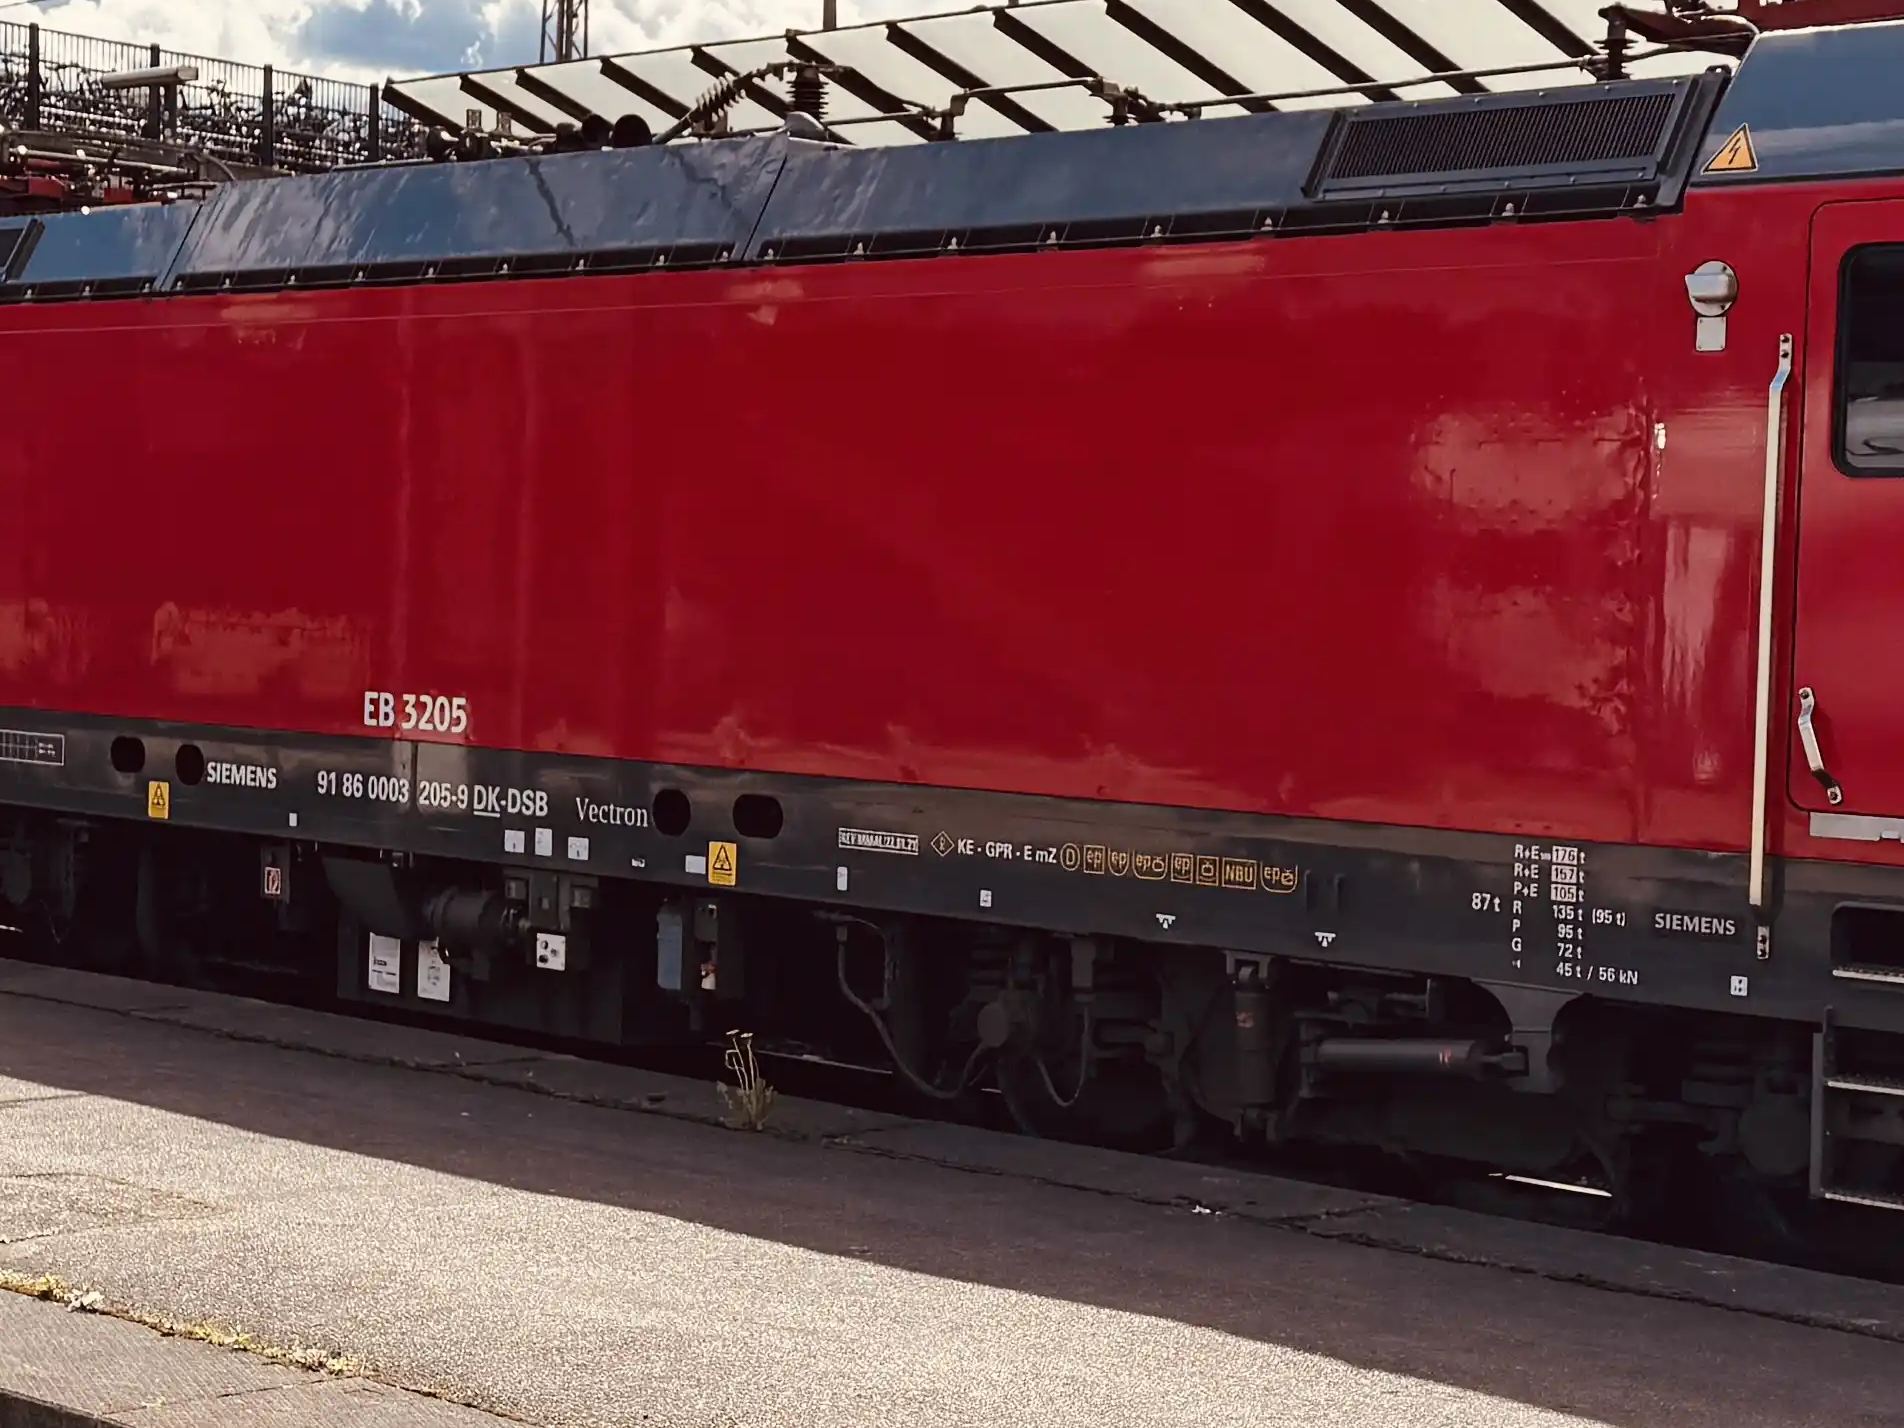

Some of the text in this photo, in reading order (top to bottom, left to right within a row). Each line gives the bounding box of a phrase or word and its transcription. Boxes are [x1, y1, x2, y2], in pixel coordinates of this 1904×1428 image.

[363, 691, 467, 733] EB 3205
[206, 761, 277, 789] SIEMENS
[317, 770, 549, 817] 91 86 0003 205-9 DK-DSB
[575, 797, 648, 828] Vectron
[957, 838, 975, 855] KE
[985, 841, 1012, 860] GPR
[1036, 847, 1057, 863] mZ
[1086, 850, 1102, 868] ep
[1111, 851, 1127, 869] ep
[1554, 847, 1576, 863] 176
[1580, 851, 1586, 864] t
[1553, 866, 1576, 882] 157
[1579, 871, 1585, 884] t
[1471, 892, 1501, 912] 87 t
[1552, 885, 1576, 901] 105
[1578, 889, 1585, 902] t
[1513, 900, 1522, 914] R
[1552, 904, 1575, 920] 135
[1577, 908, 1583, 921] t
[1592, 908, 1613, 924] (95
[1512, 919, 1583, 940] P 95 t
[1654, 913, 1736, 935] SIEMENS
[1512, 938, 1582, 959] G 72 t
[1556, 962, 1573, 977] 45
[1576, 966, 1582, 978] t
[1599, 966, 1616, 982] 56
[1619, 969, 1638, 985] kN
